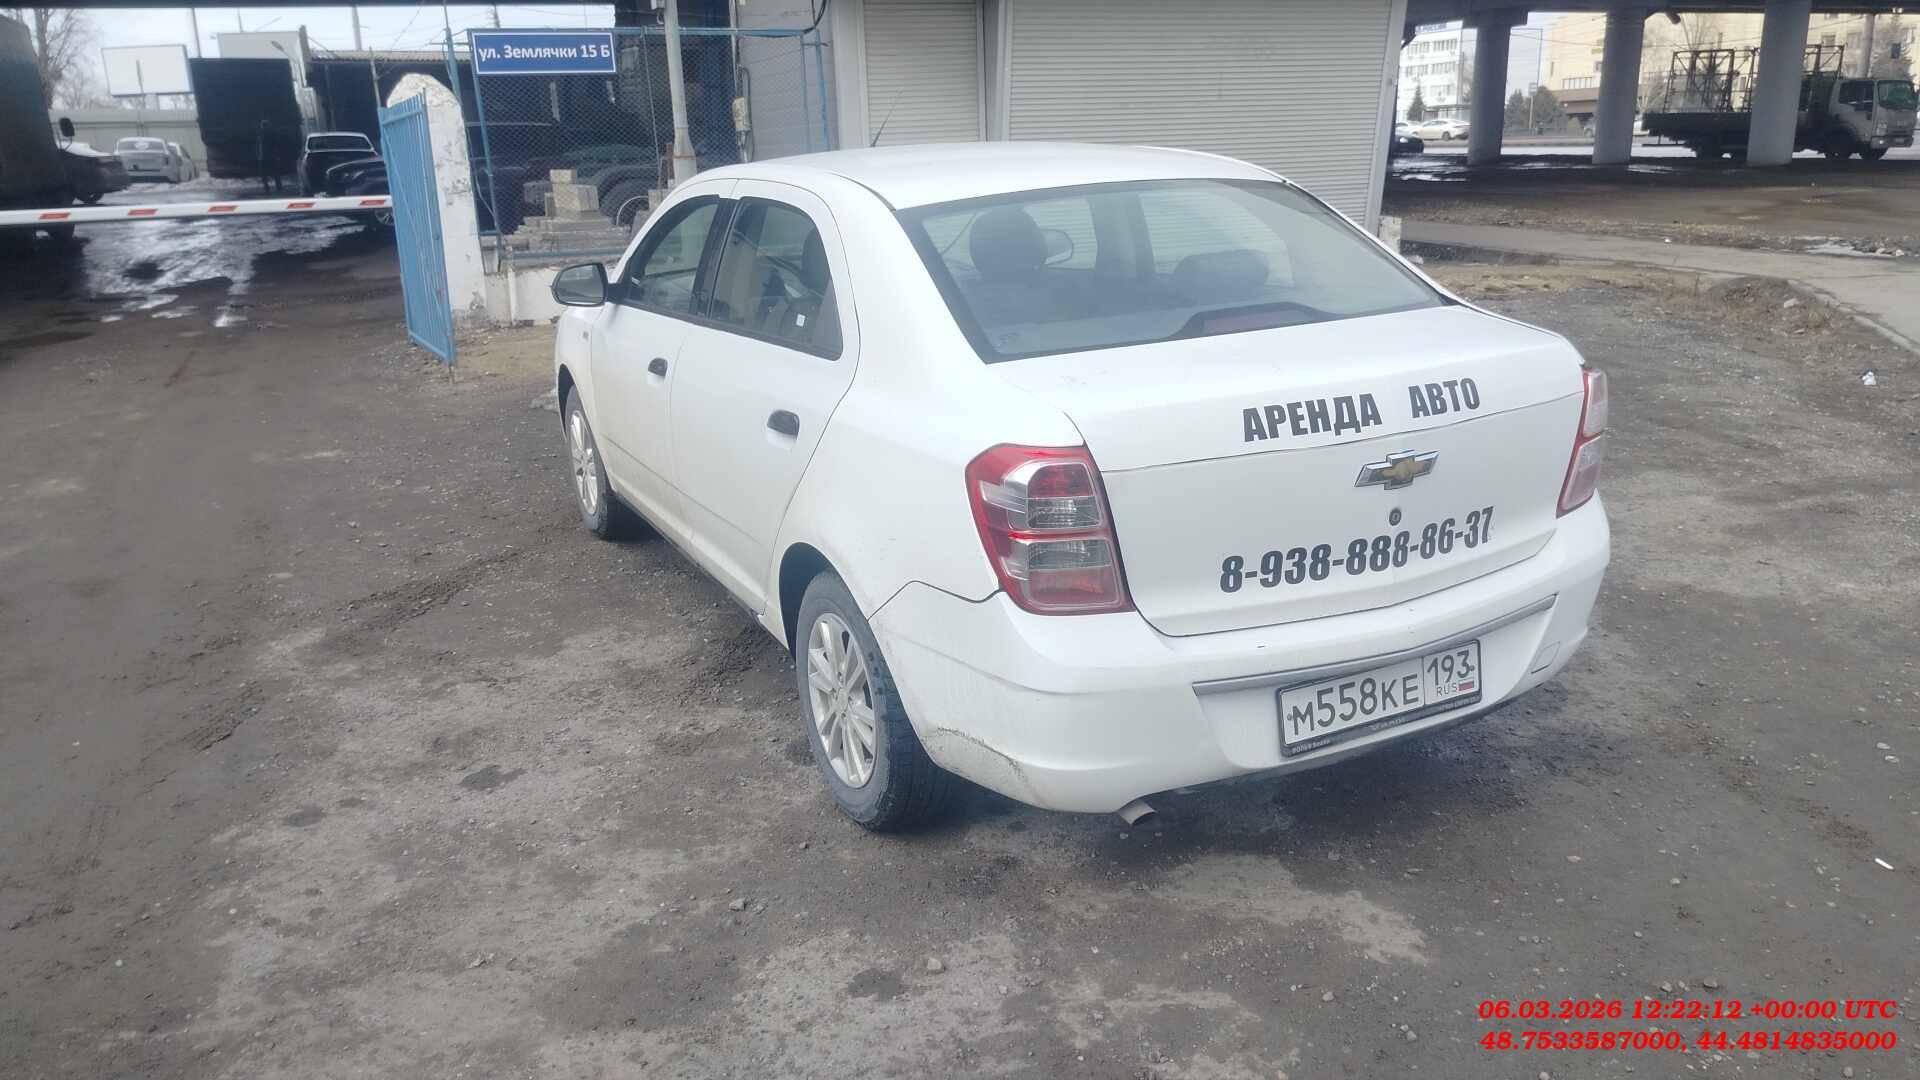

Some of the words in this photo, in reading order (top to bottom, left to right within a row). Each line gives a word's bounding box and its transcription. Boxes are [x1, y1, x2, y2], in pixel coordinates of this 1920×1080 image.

[479, 48, 500, 62] ул.
[503, 45, 577, 58] Землячки
[580, 45, 597, 58] 15
[600, 45, 610, 58] Б
[1242, 393, 1382, 442] АРЕНДА
[1408, 378, 1480, 418] АВТО
[1220, 506, 1494, 593] 8-938-888-86-37
[1427, 650, 1470, 686] 193
[1436, 682, 1457, 697] RUS
